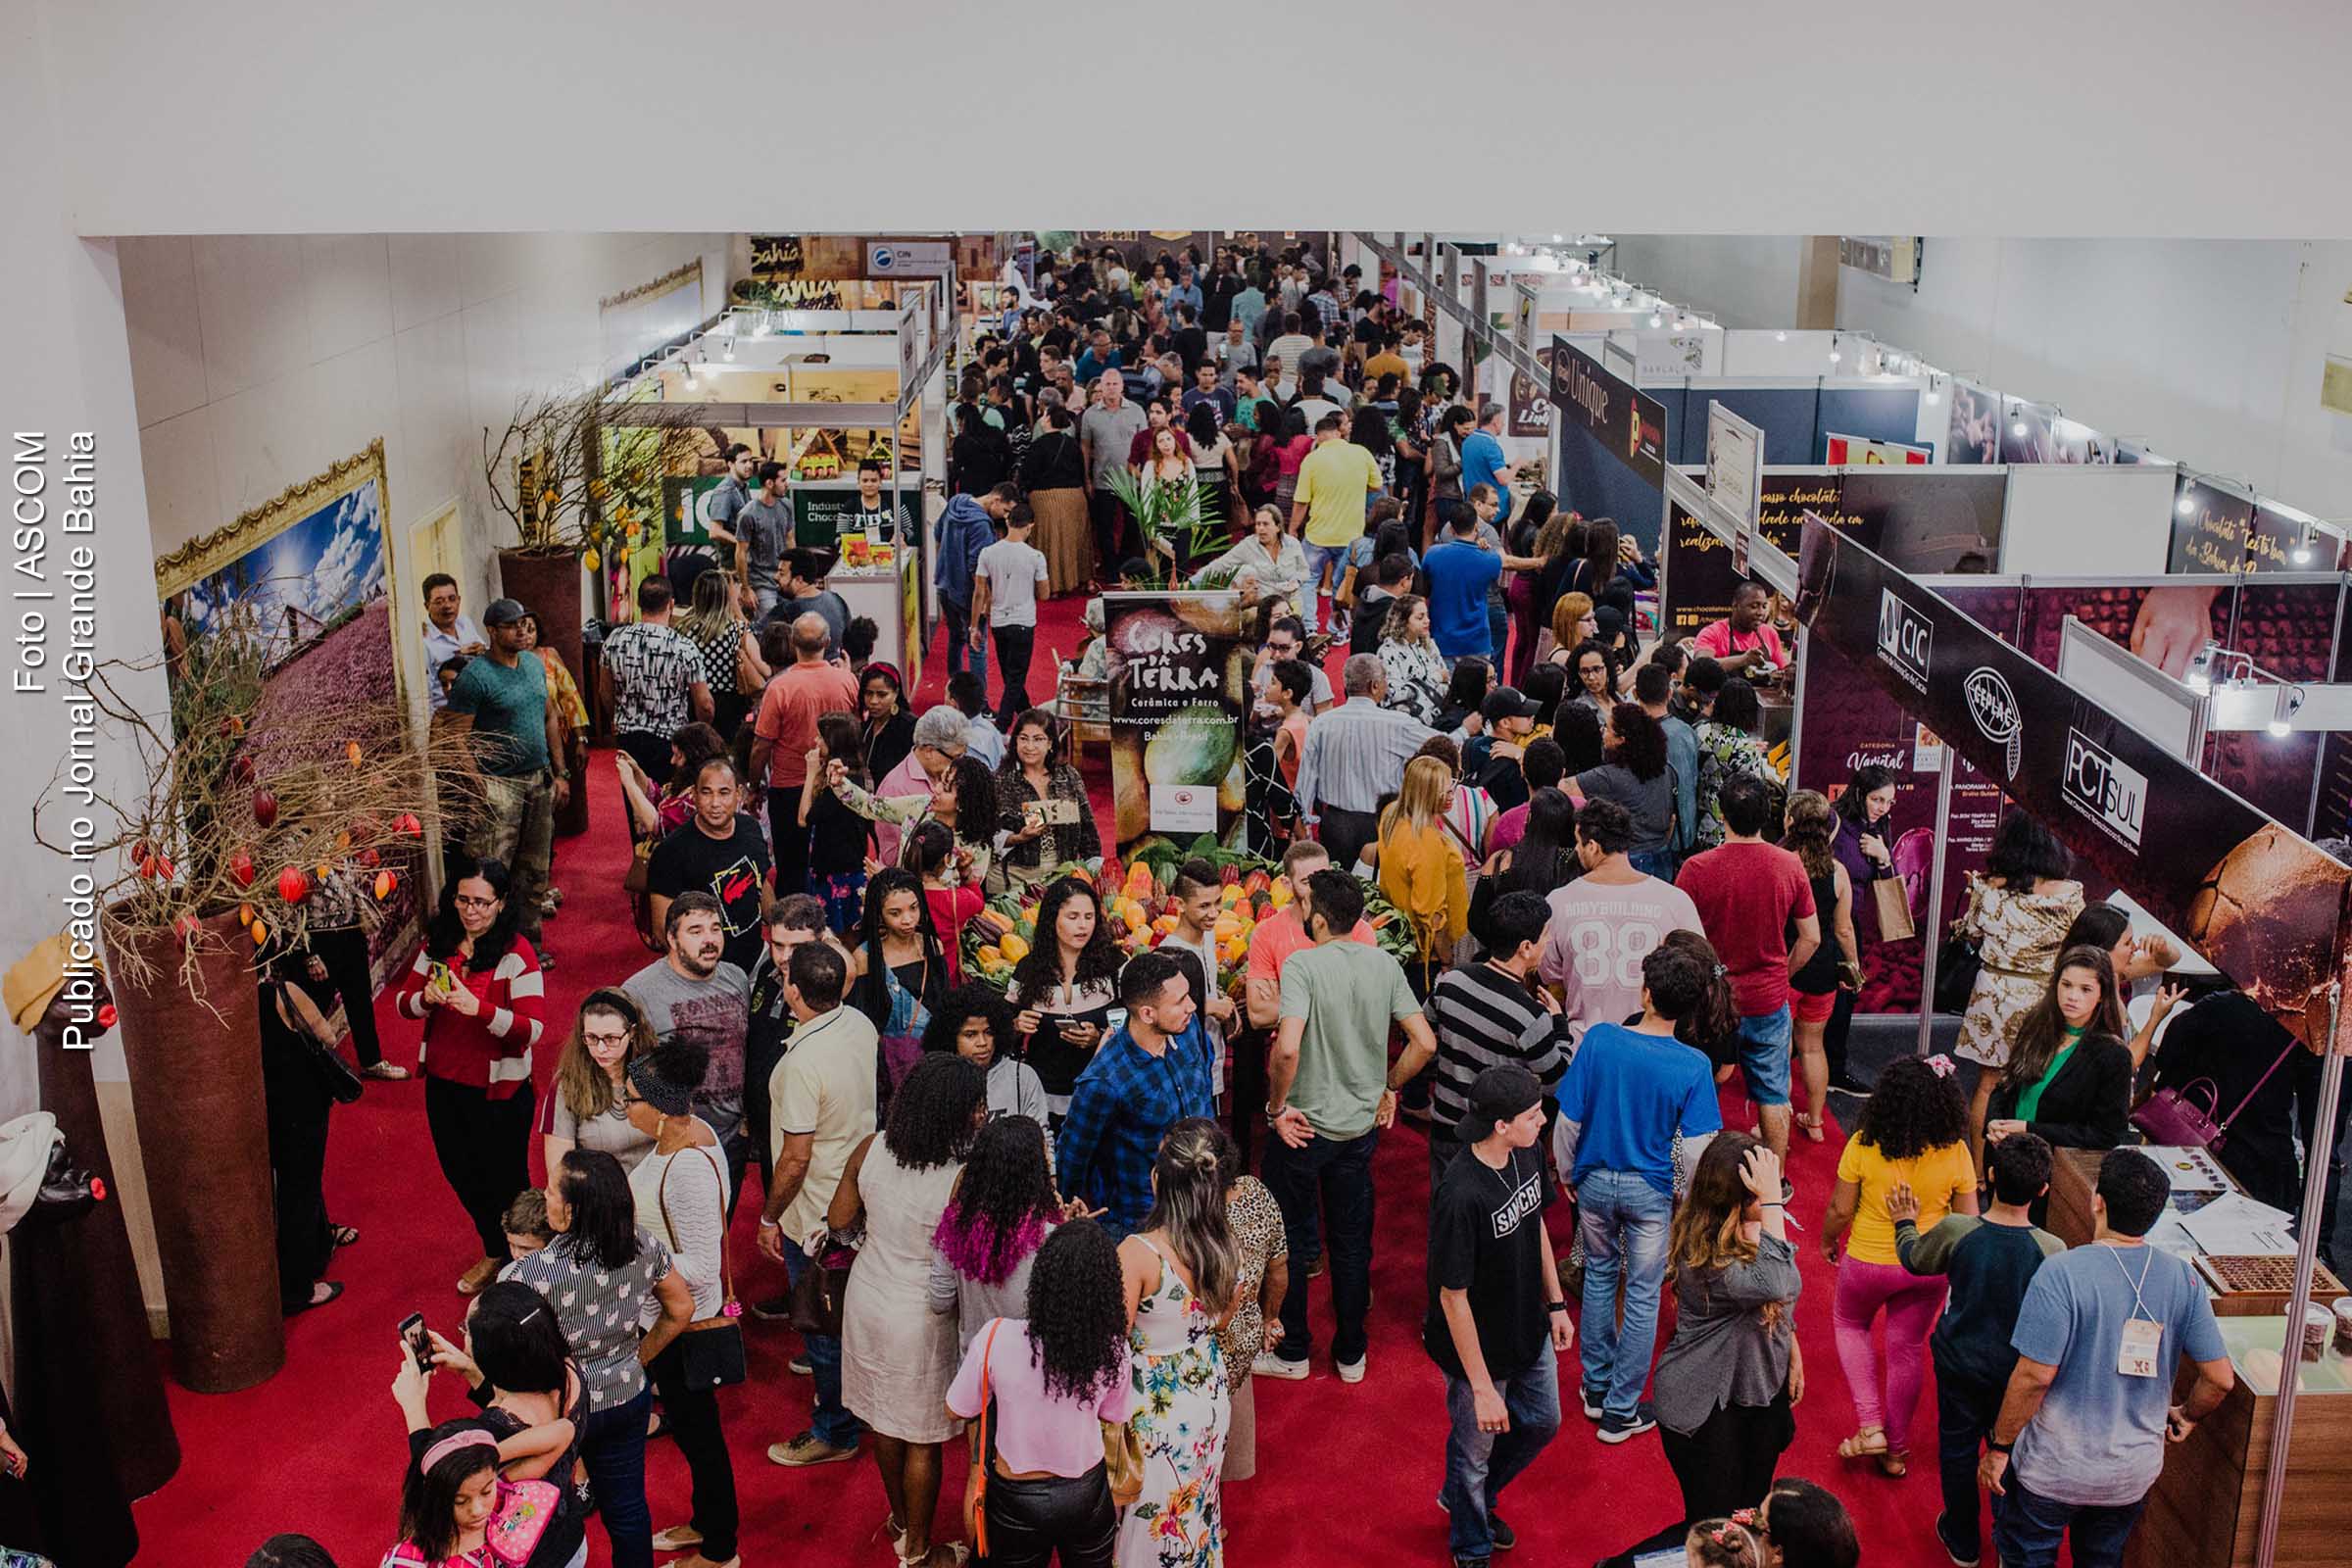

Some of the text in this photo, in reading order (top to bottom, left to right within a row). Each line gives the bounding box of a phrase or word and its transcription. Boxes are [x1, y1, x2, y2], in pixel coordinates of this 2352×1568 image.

[1570, 358, 1609, 427] Unique
[1128, 620, 1207, 655] CORES
[1902, 618, 1928, 666] CIC
[1127, 658, 1220, 692] TERRA
[1149, 654, 1171, 667] DA
[1131, 697, 1179, 708] Cerâmica
[1192, 697, 1220, 708] Ferro
[1973, 684, 2012, 728] CEPLAC
[1112, 714, 1240, 726] www.coresdaterra.com.br
[1847, 749, 1905, 771] Varietal
[1570, 919, 1661, 989] 88
